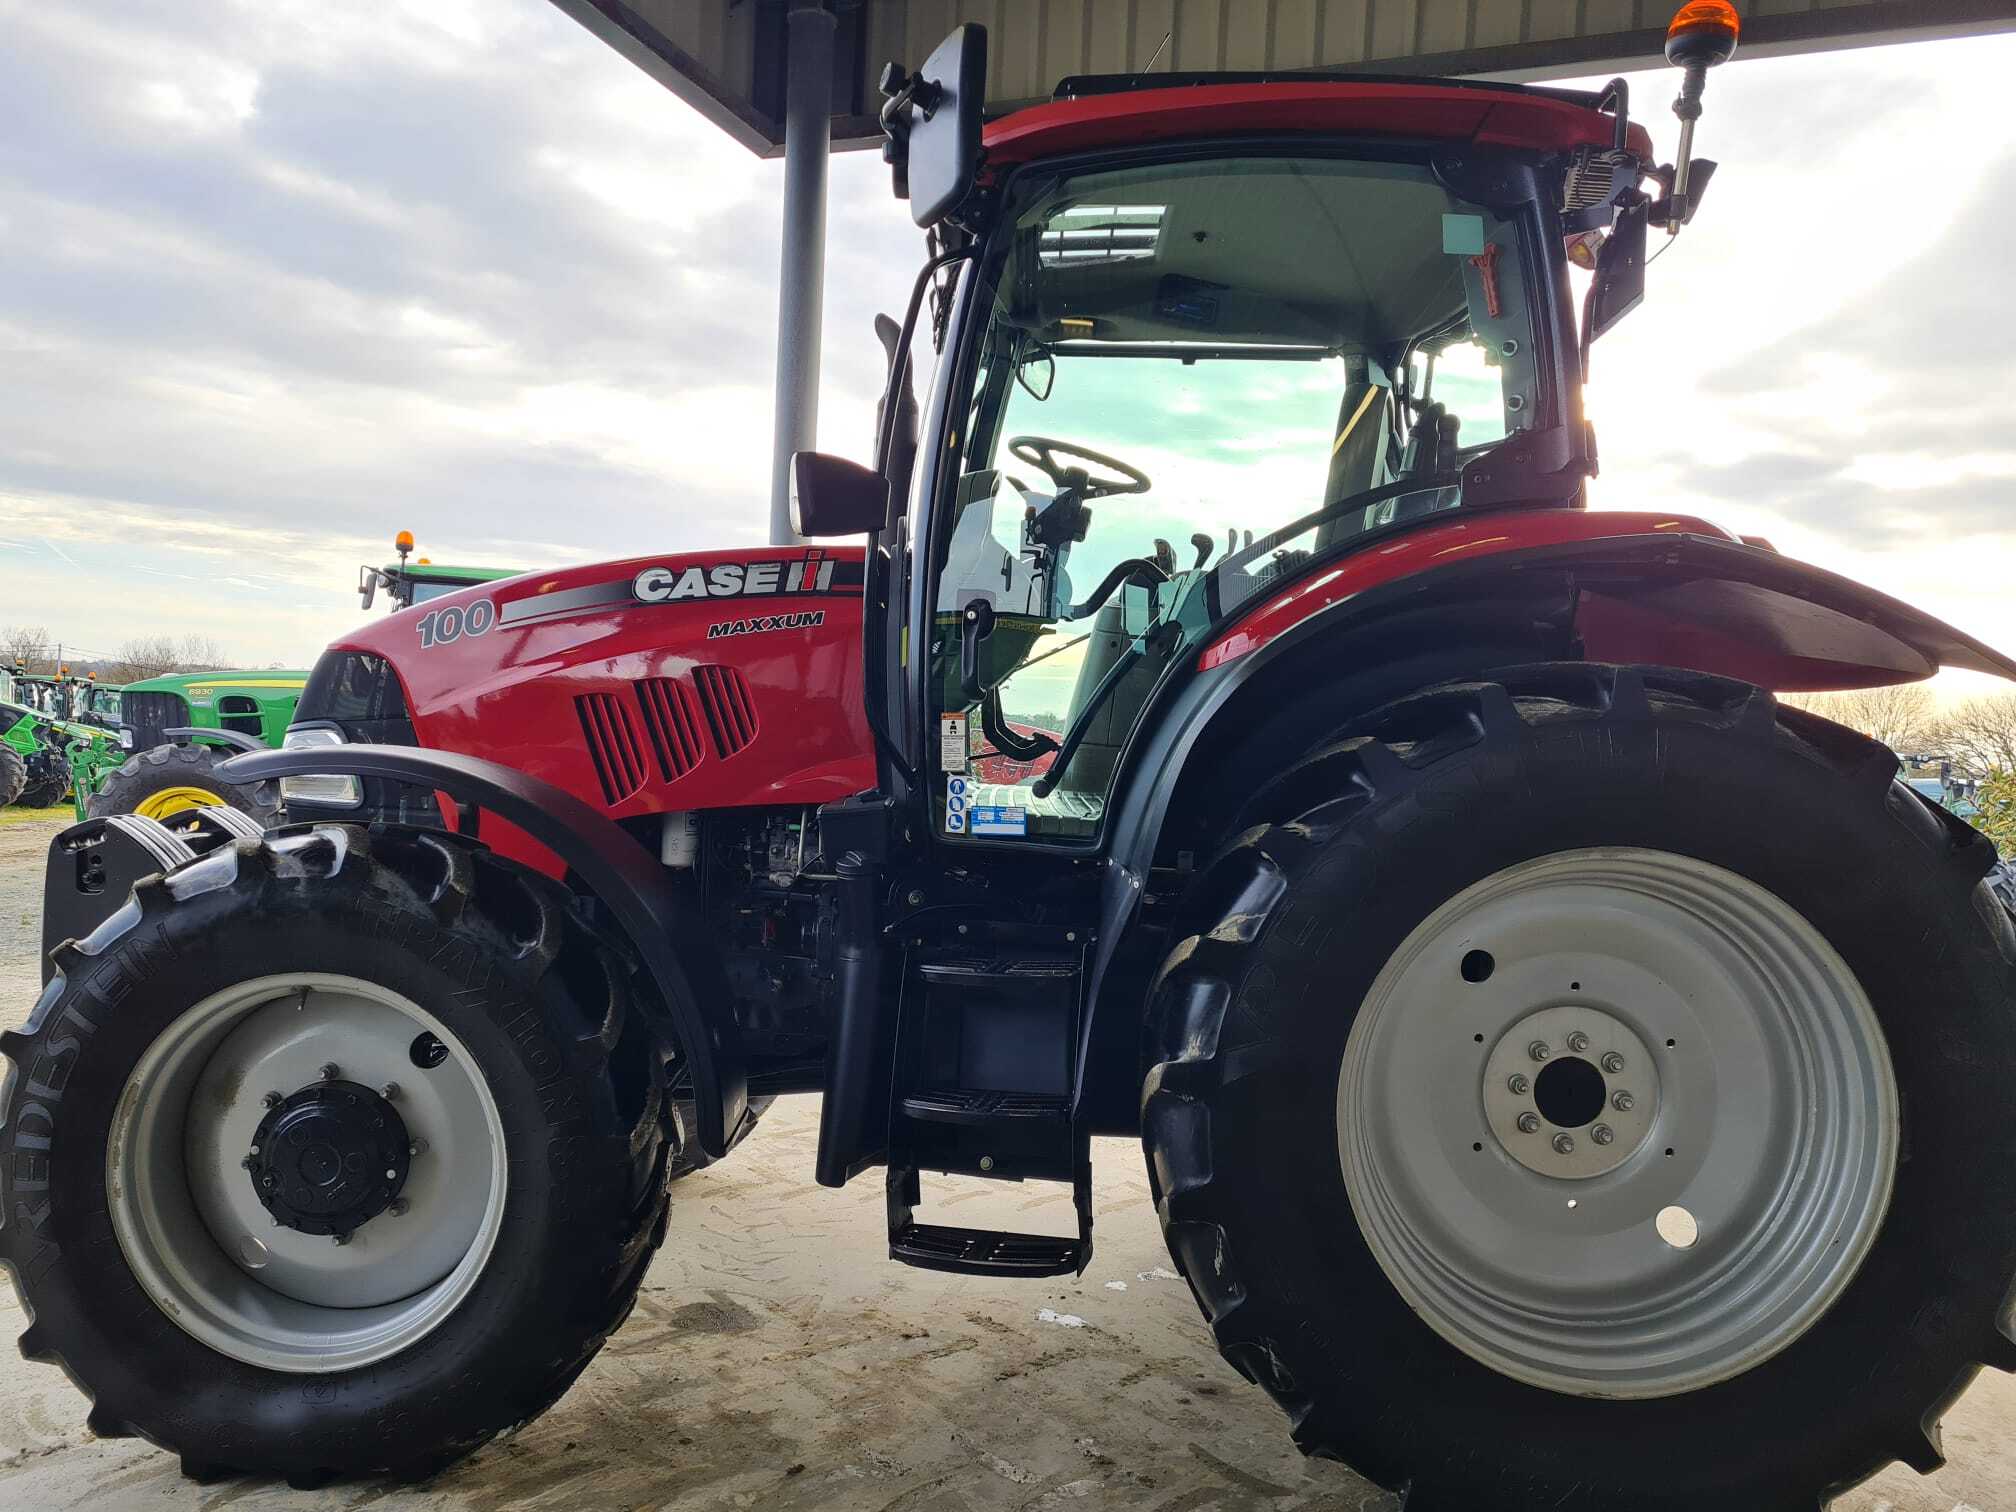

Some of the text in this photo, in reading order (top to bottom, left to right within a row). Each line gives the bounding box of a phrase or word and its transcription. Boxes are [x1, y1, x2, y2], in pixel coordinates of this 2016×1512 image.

[633, 563, 782, 602] CASE
[416, 598, 495, 649] 100
[707, 610, 825, 638] MAXXUM
[10, 920, 180, 1289] VREDESTEIN
